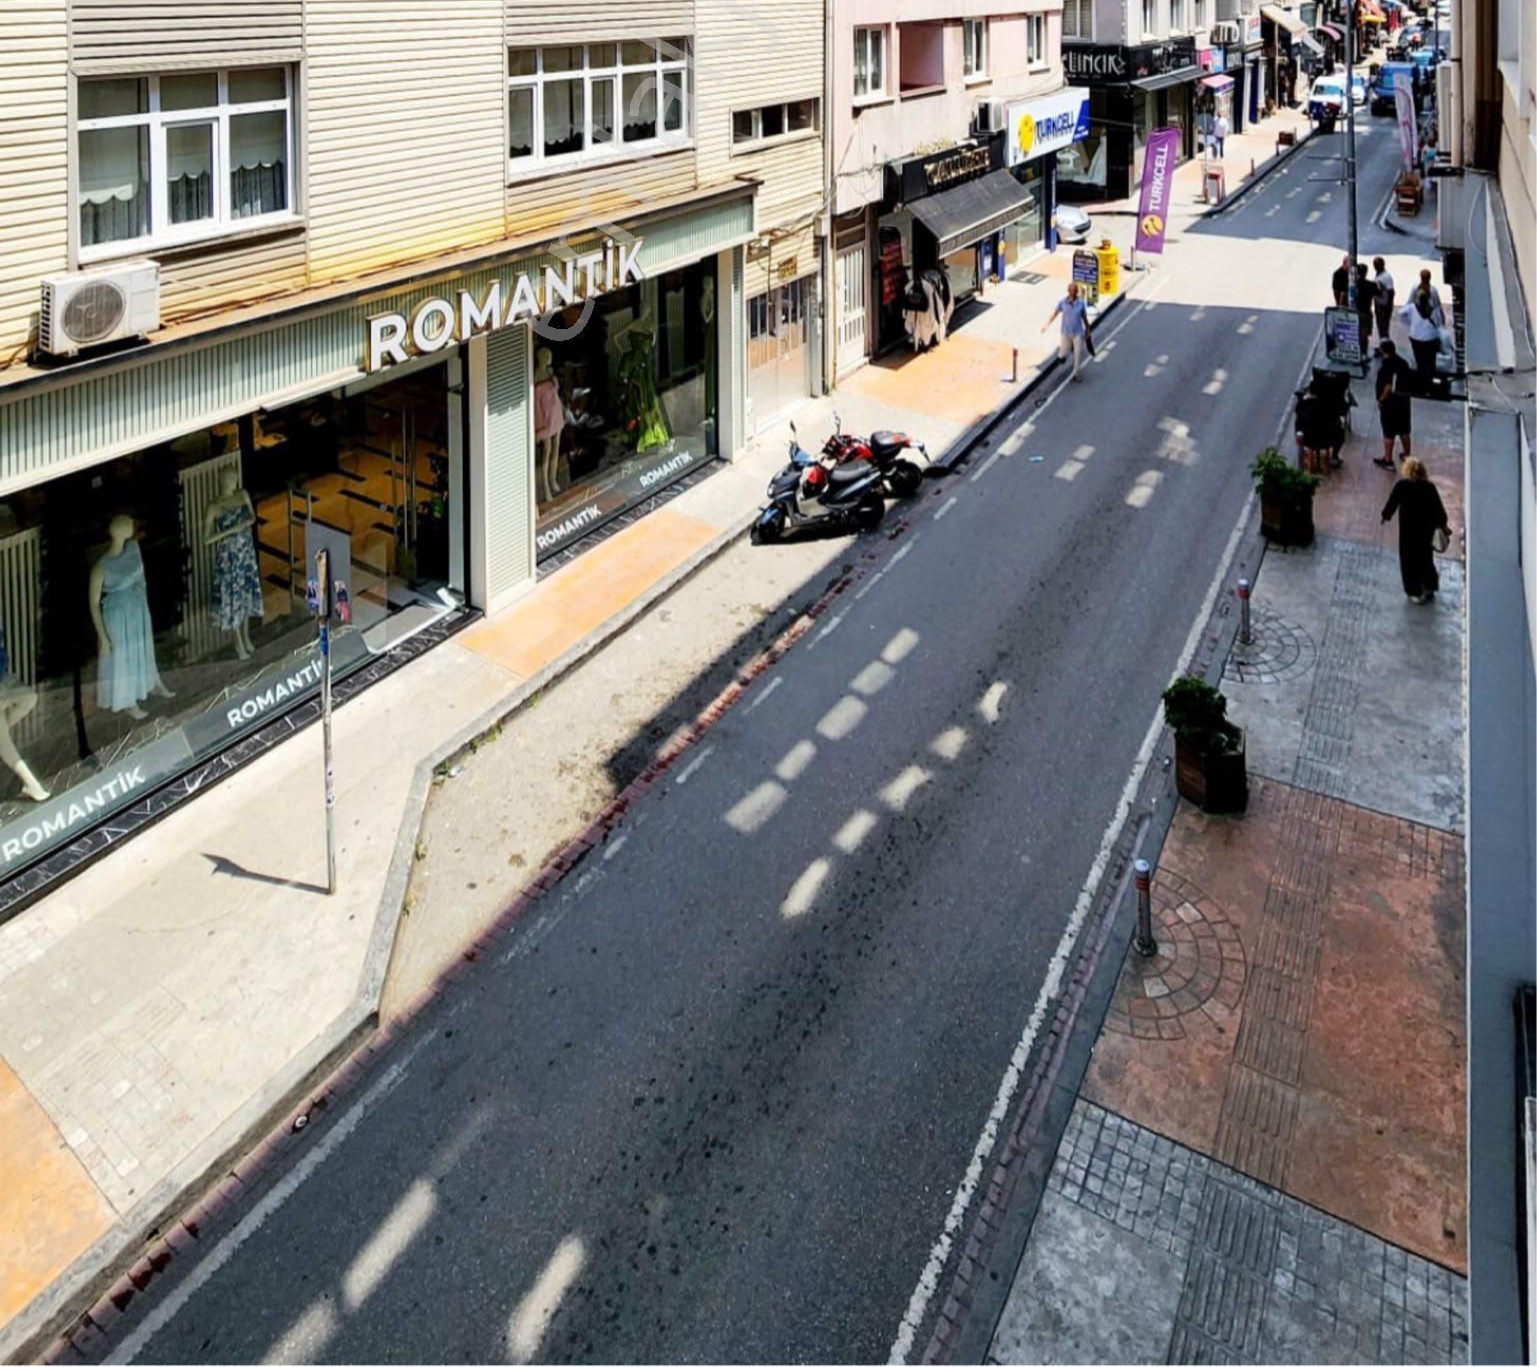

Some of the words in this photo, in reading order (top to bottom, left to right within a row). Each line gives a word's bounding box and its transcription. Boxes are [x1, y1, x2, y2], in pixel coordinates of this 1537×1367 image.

[1036, 111, 1074, 140] TURKCELL
[1148, 144, 1169, 212] TURKCELL
[367, 236, 646, 372] ROMANTİK
[639, 450, 693, 488] ROMANTİK
[536, 504, 602, 549] ROMANTİK
[1, 765, 146, 862] ROMANTİK
